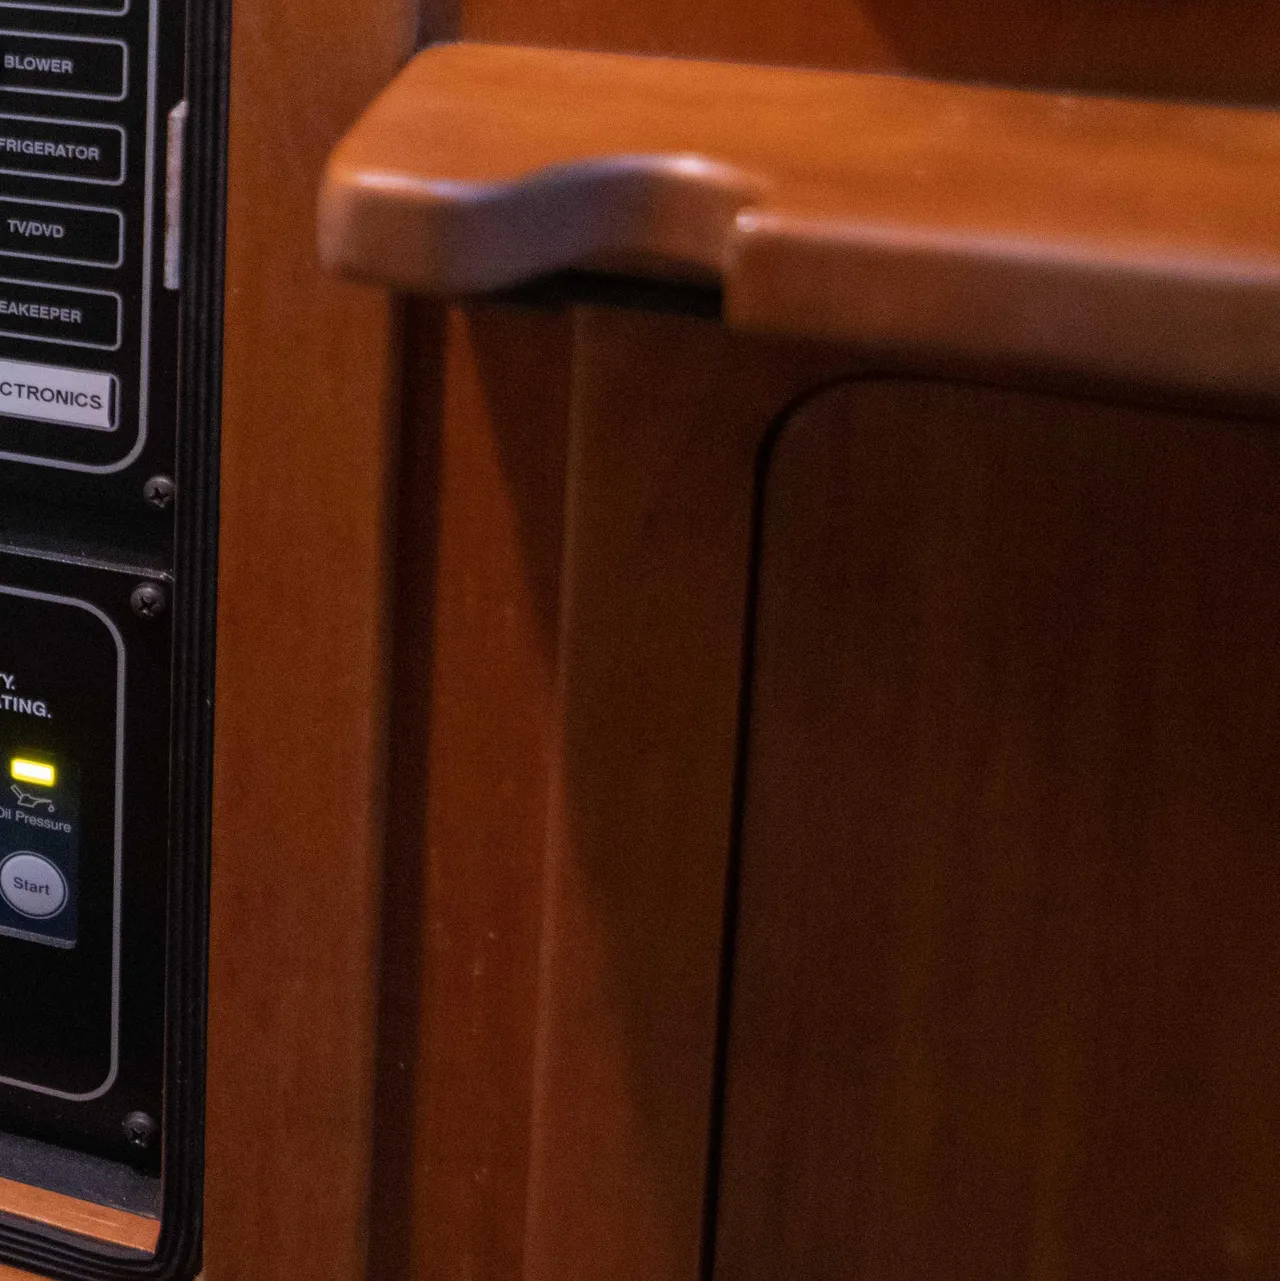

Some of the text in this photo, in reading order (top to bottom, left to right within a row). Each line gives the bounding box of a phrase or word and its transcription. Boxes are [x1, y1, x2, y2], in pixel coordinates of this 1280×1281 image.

[4, 54, 73, 74] BLOWER
[7, 219, 64, 238] TV/DVD
[15, 811, 72, 833] Pressure
[13, 876, 50, 896] Start
